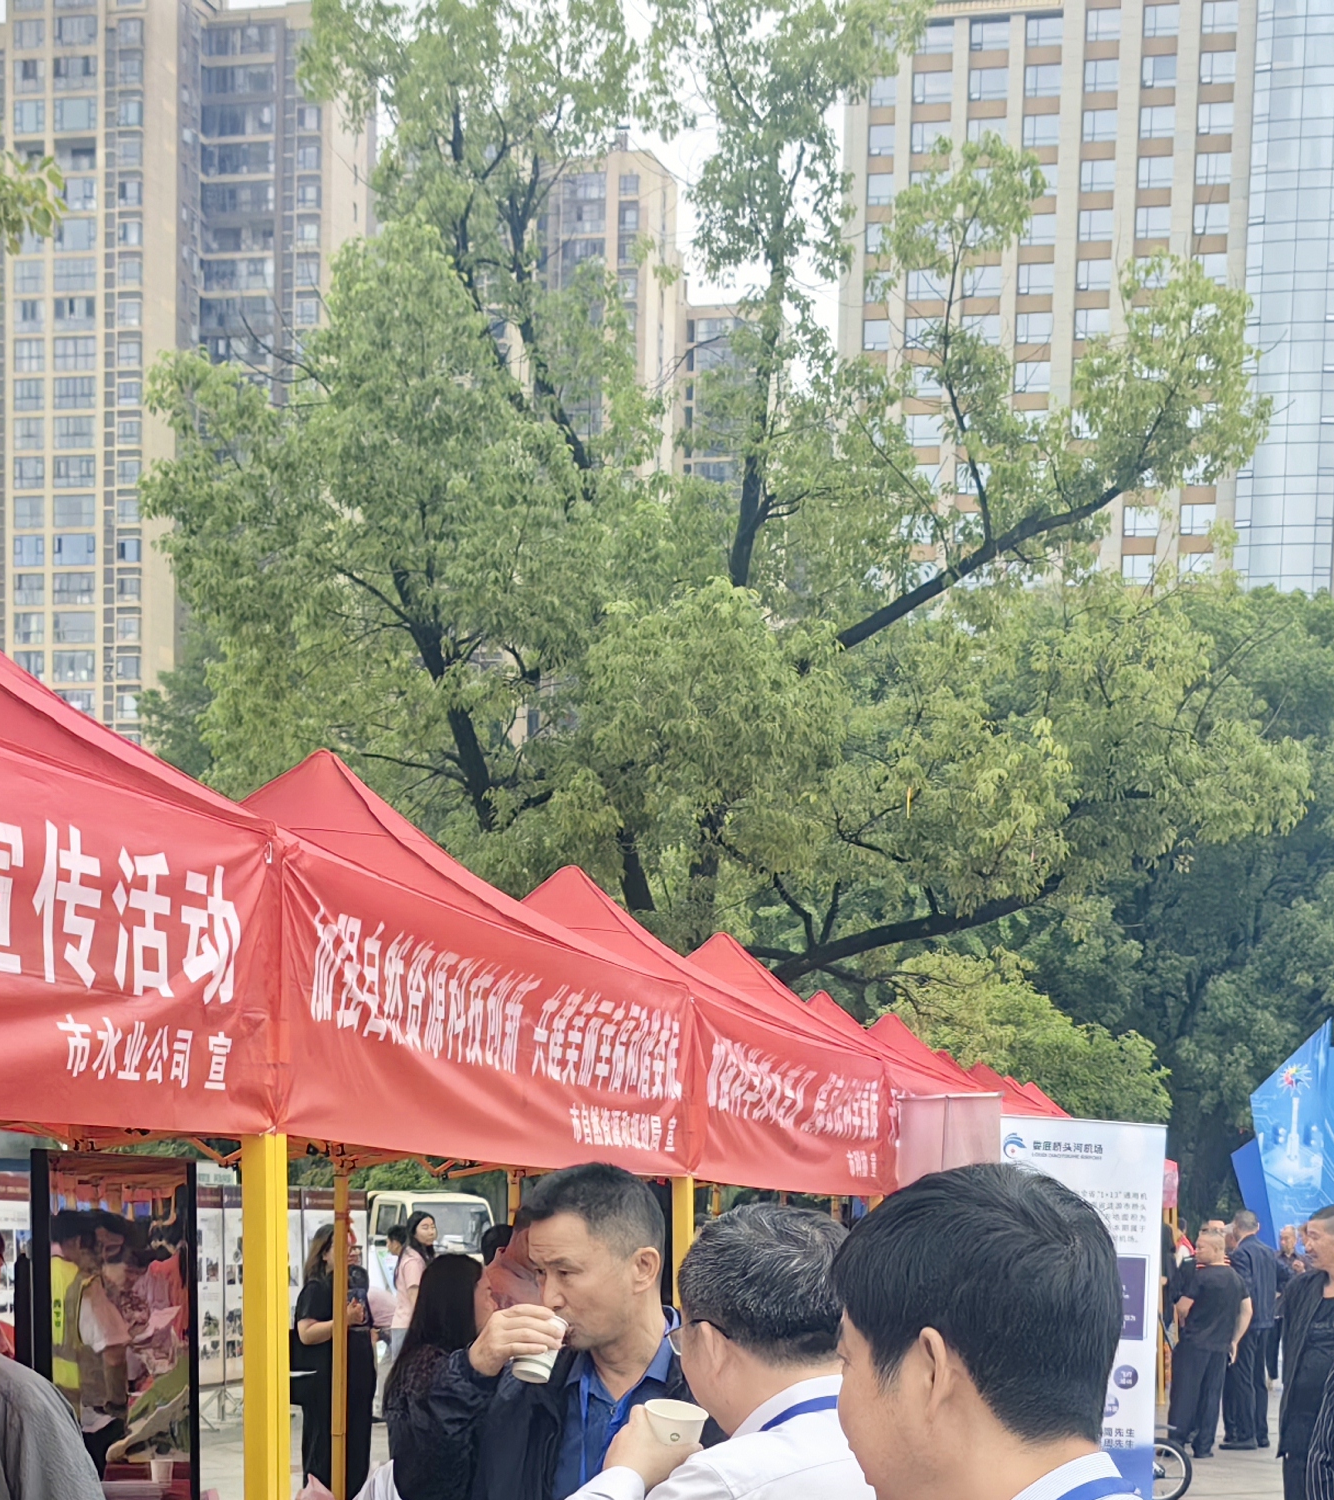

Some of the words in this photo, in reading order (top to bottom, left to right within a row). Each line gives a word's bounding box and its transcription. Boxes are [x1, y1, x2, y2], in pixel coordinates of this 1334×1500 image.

[310, 905, 543, 1075] 加强自然资源科技创新
[56, 1013, 193, 1091] 市水业公司
[204, 1031, 233, 1092] 宣
